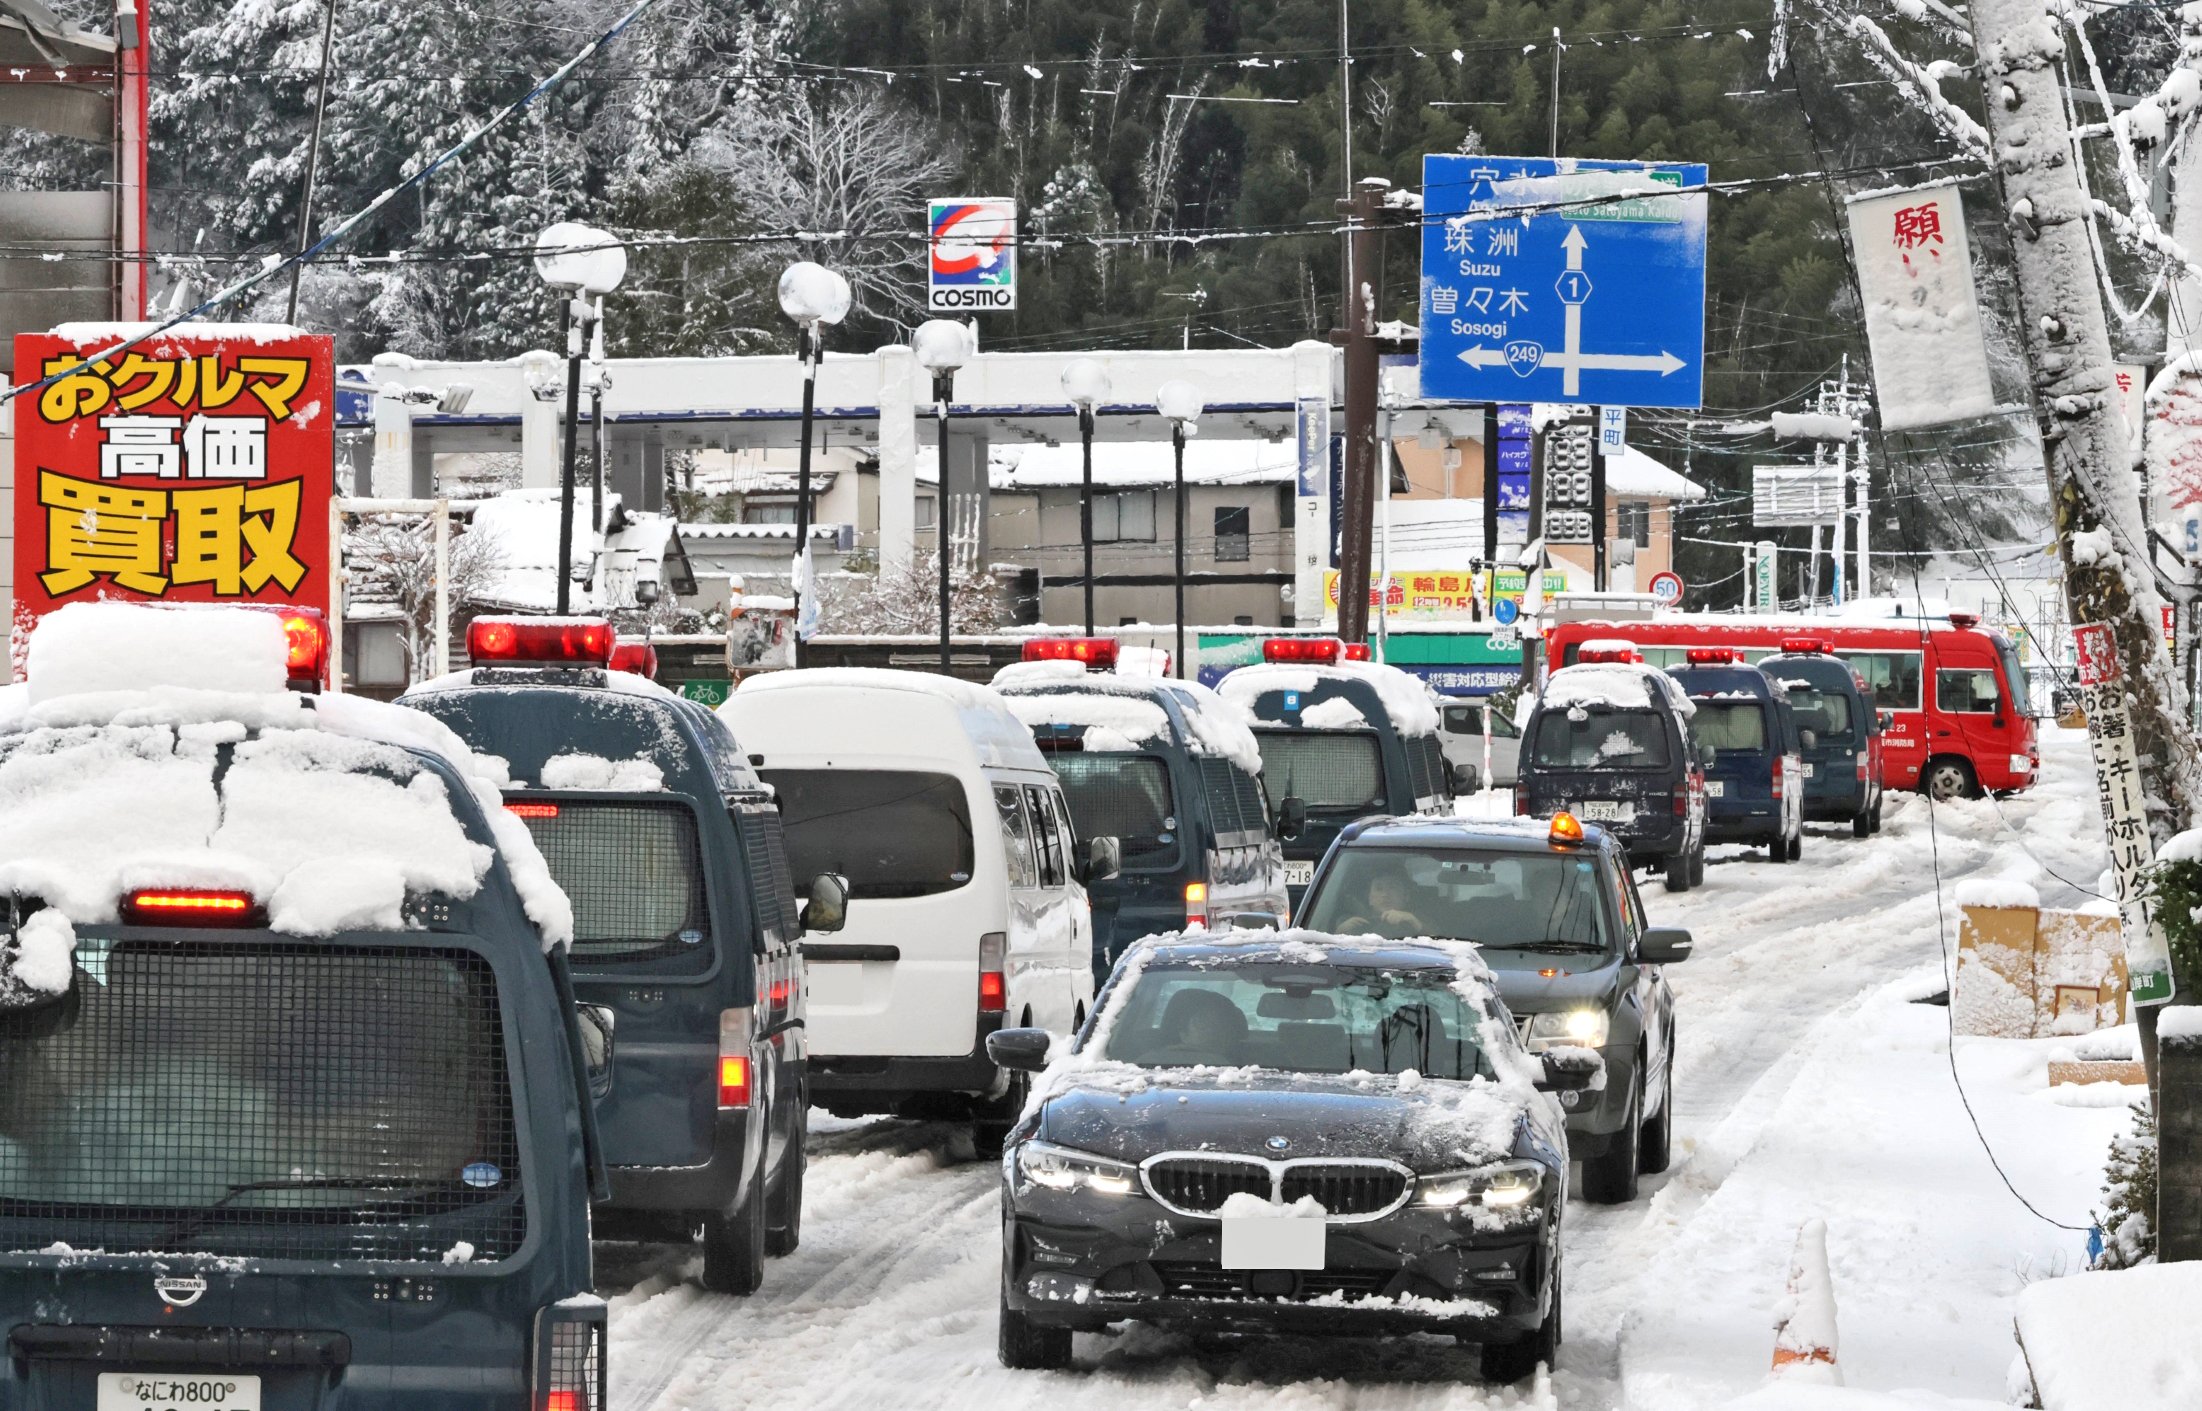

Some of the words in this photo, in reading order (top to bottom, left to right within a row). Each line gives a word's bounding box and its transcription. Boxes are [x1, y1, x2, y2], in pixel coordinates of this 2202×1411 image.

[1444, 227, 1518, 257] 珠洲
[1459, 260, 1501, 277] Suzu
[932, 289, 1011, 307] COSMO
[1568, 277, 1578, 298] 1
[1431, 286, 1529, 317] 曽々木
[1450, 318, 1508, 339] Sosogi
[1509, 346, 1538, 363] 249
[40, 352, 309, 423] おクルマ
[1604, 408, 1622, 446] 平町
[99, 413, 268, 479] 高価
[38, 468, 309, 597] 買取
[1656, 581, 1676, 597] 50
[160, 1280, 202, 1289] NISSAN
[136, 1380, 226, 1402] なにわ800
